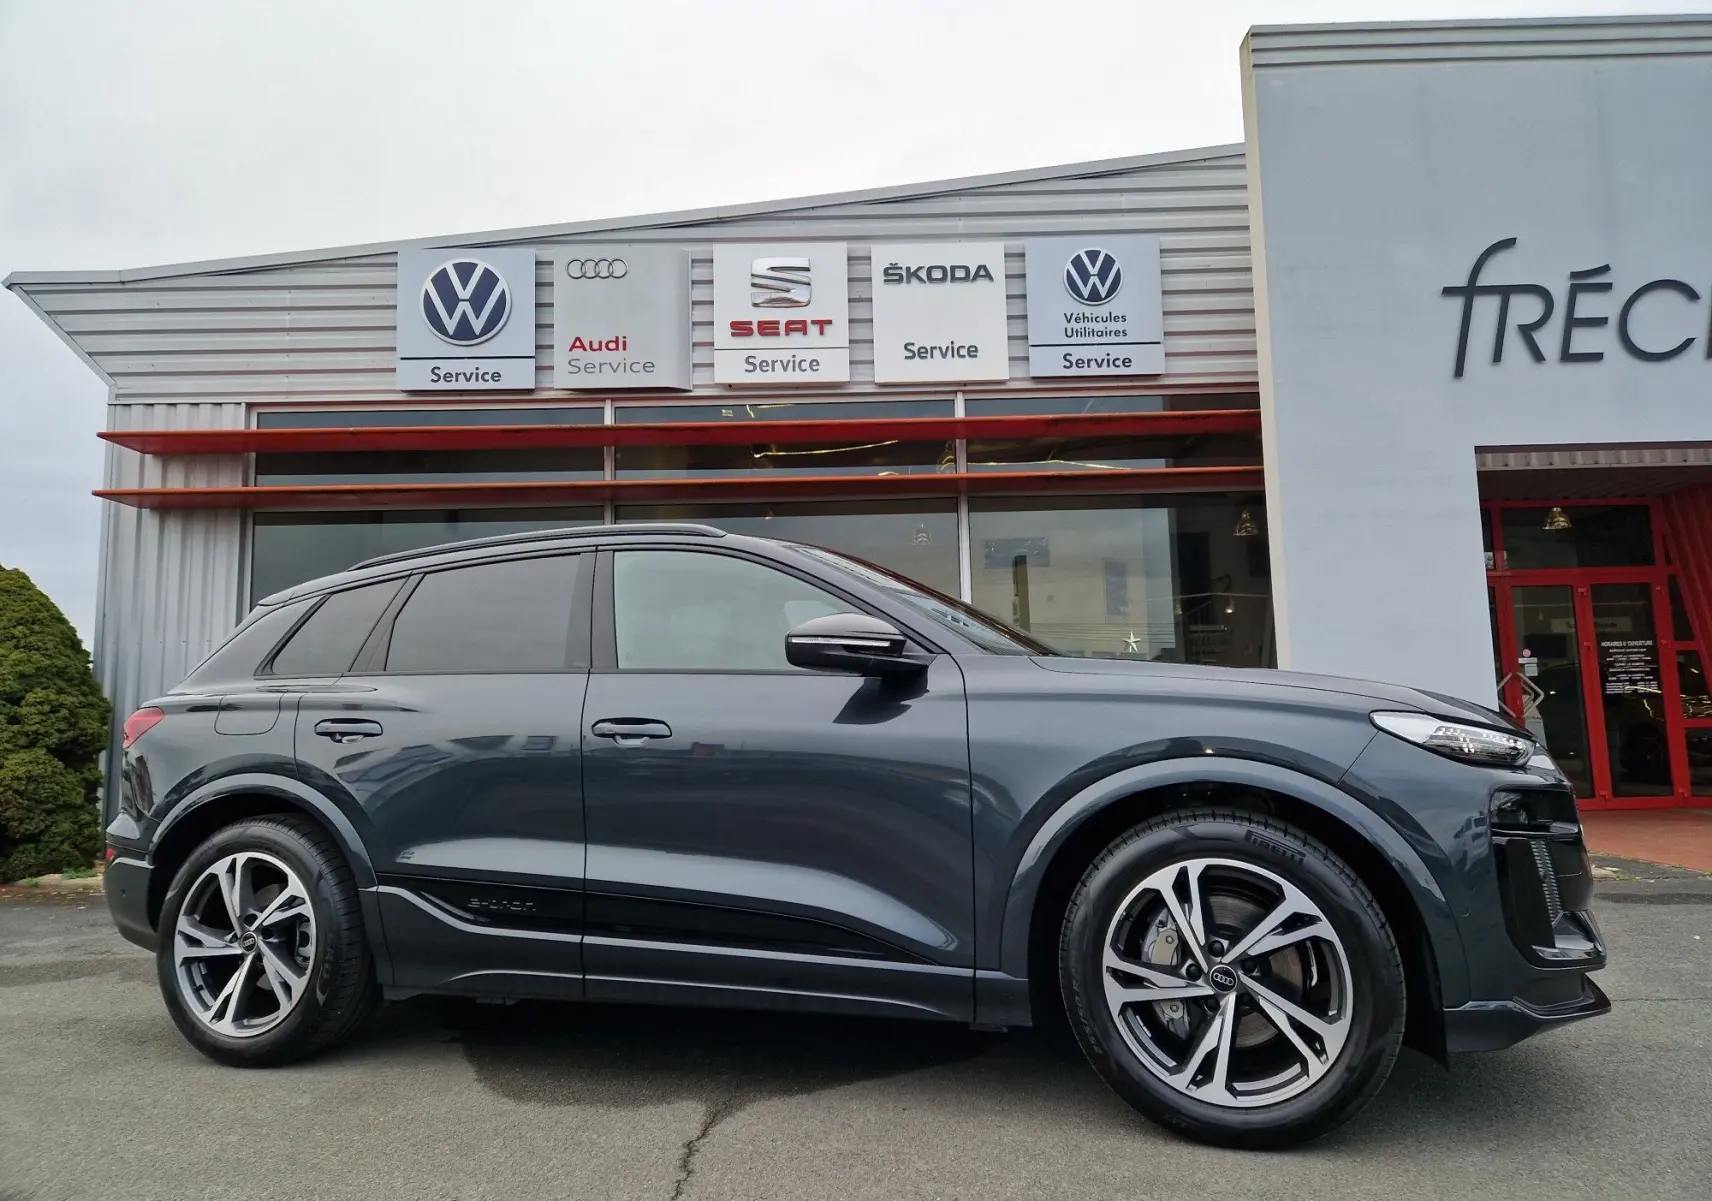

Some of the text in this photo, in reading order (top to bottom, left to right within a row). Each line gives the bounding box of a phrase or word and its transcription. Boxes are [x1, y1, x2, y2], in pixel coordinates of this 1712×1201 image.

[883, 262, 995, 285] ŠKODA
[1441, 236, 1712, 379] fRÉC
[1063, 311, 1127, 324] Véhicules
[729, 319, 833, 337] SEAT
[1064, 326, 1128, 338] Utilitaires
[568, 336, 628, 352] Audi
[903, 340, 979, 360] Service
[567, 357, 656, 375] Service
[744, 354, 820, 373] Service
[1062, 352, 1133, 369] Service
[429, 366, 502, 383] Service
